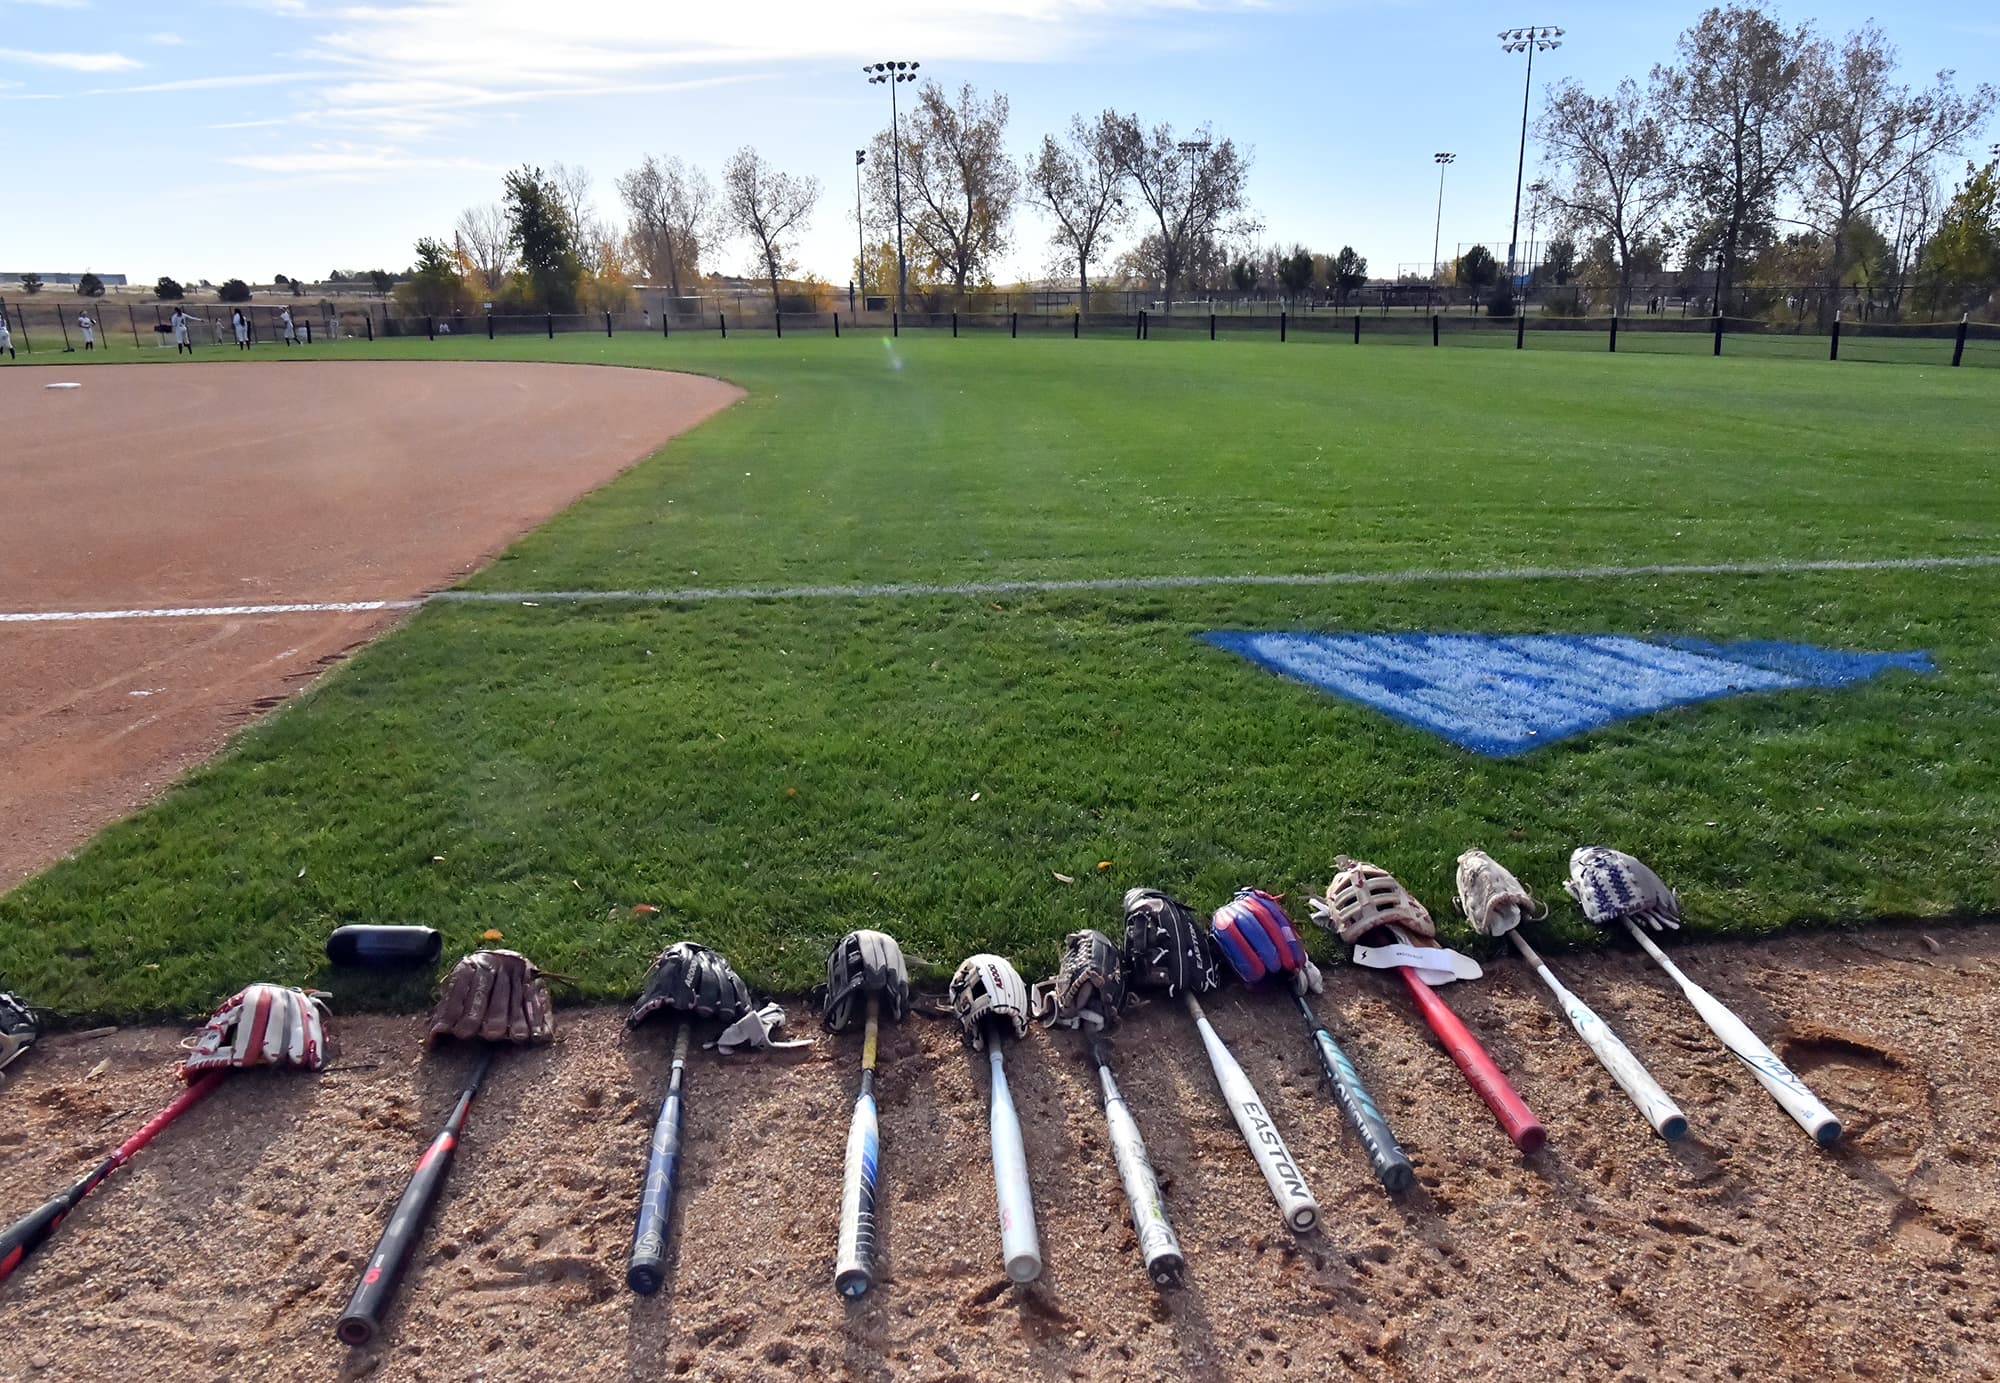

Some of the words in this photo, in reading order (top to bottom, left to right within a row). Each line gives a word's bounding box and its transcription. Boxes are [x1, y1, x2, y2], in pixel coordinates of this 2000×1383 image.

[1188, 922, 1203, 969] EASTON
[988, 964, 1004, 990] A2000
[1242, 1102, 1308, 1199] EASTON
